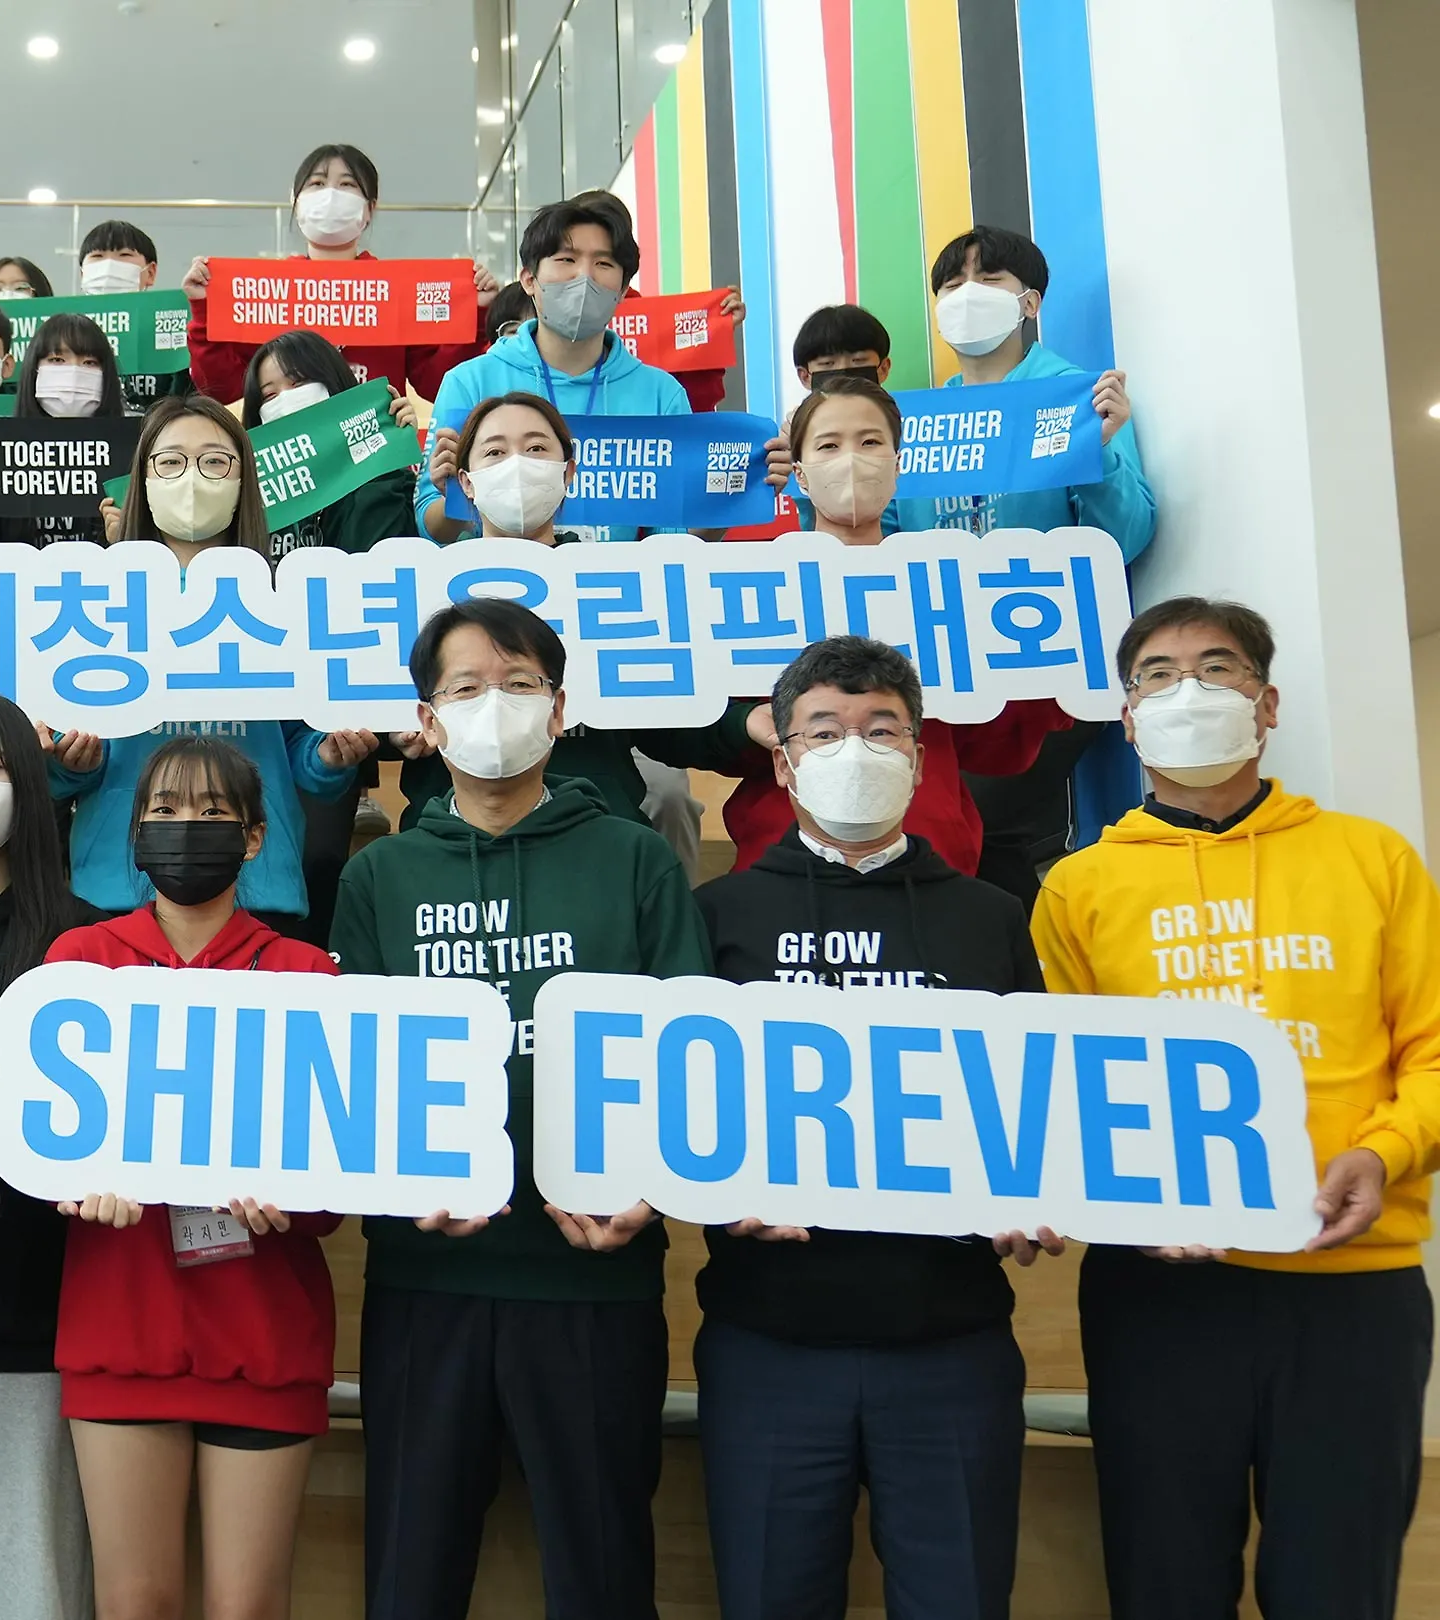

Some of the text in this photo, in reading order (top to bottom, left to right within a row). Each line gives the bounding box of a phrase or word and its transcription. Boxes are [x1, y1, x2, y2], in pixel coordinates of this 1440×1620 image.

[232, 277, 389, 301] GROW TOGETHER
[416, 291, 450, 303] 2024
[155, 319, 187, 332] 2024
[233, 303, 377, 326] SHINE FOREVER
[675, 319, 708, 333] 2024
[339, 408, 376, 431] GANGWON
[1035, 404, 1078, 420] GANGWON
[344, 418, 380, 446] 2024
[901, 410, 1002, 443] OGETHER
[1034, 416, 1073, 438] 2024
[1, 440, 110, 467] TOGETHER
[253, 434, 317, 478] THER
[571, 438, 673, 467] OGETHER
[708, 442, 752, 453] GANGWON
[899, 444, 985, 475] OREVER
[707, 453, 750, 470] 2024
[2, 470, 98, 495] FOREVER
[258, 466, 317, 507] EVER
[566, 471, 657, 499] OREVER
[415, 899, 509, 937] GROW
[1151, 899, 1254, 942] GROW
[414, 931, 574, 978] TOGETHER
[22, 998, 471, 1178] SHINE
[574, 1010, 1277, 1210] FOREVER
